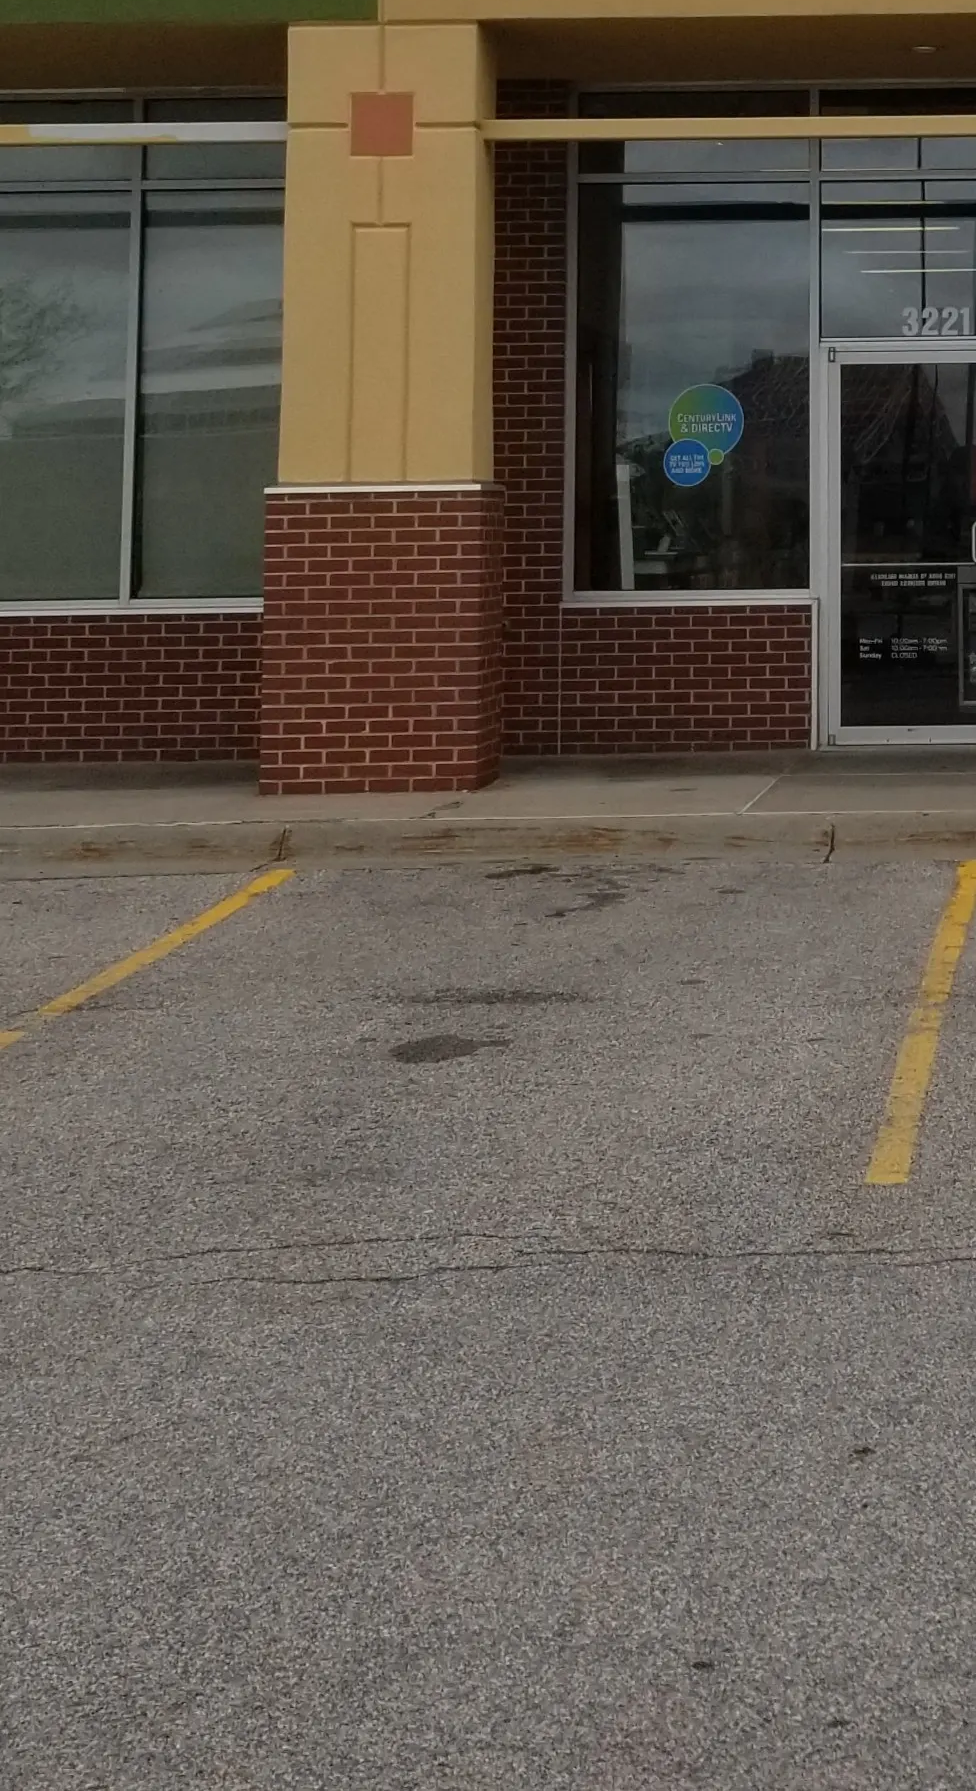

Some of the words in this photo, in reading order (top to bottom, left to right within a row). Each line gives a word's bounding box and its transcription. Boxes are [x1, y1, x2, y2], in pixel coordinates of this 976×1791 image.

[902, 306, 970, 336] 3221
[680, 423, 689, 433] &
[691, 422, 733, 433] DIRECTV
